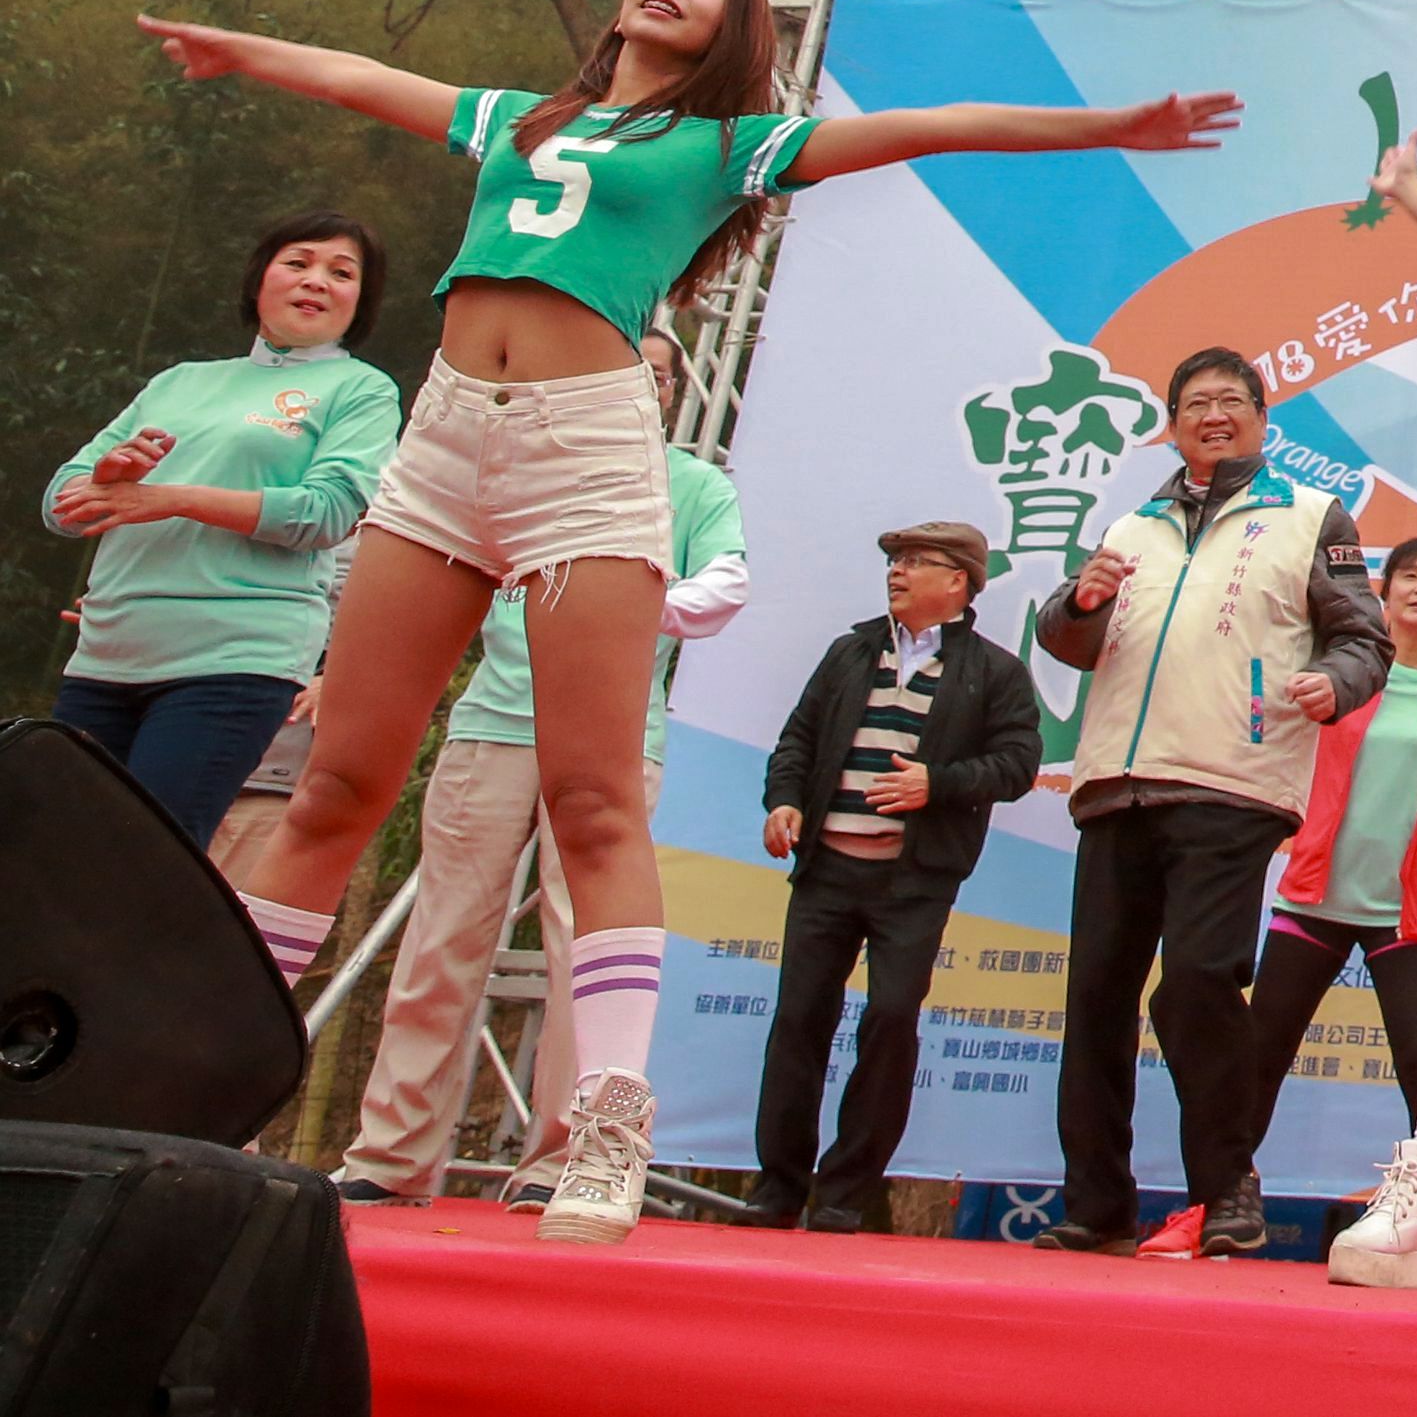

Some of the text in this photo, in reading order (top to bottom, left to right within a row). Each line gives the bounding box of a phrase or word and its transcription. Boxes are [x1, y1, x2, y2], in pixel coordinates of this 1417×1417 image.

[508, 135, 619, 239] 5
[1215, 547, 1254, 637] 新竹縣政府
[706, 938, 781, 960] 主辦單位
[932, 947, 1069, 974] 社、救國團新
[695, 994, 768, 1016] 協辦單位
